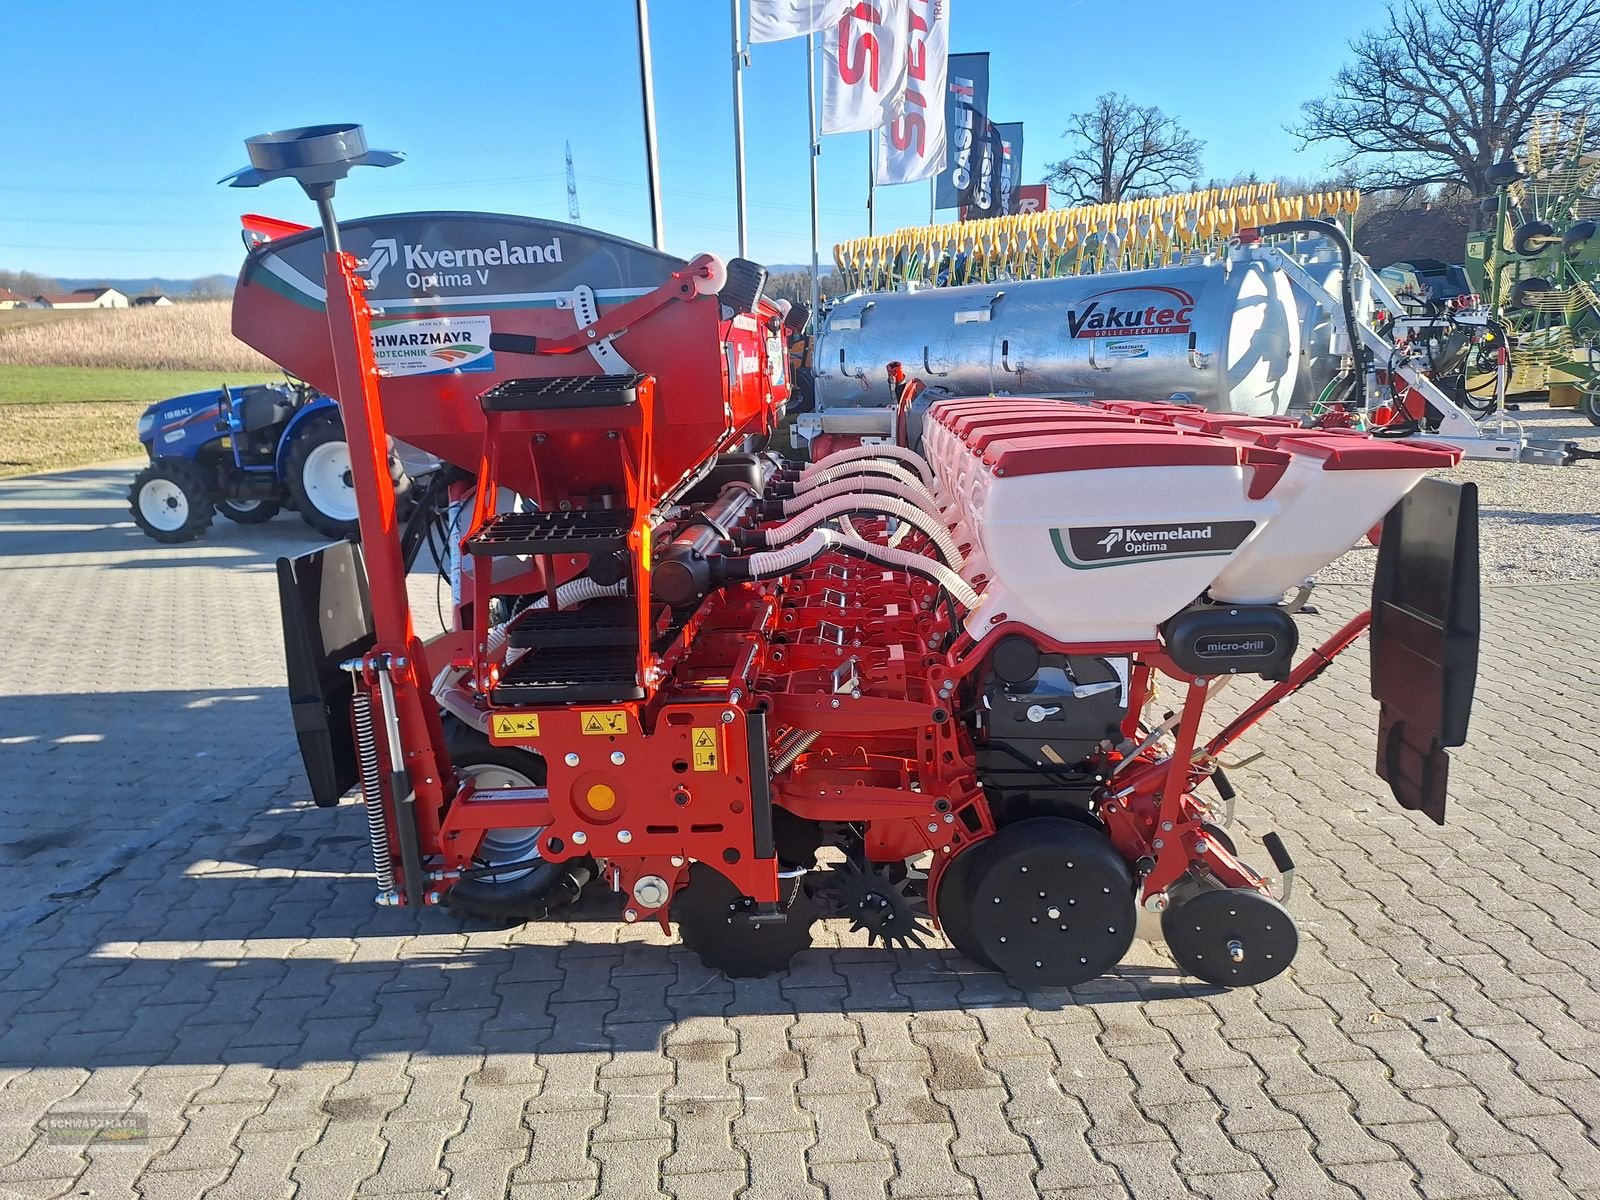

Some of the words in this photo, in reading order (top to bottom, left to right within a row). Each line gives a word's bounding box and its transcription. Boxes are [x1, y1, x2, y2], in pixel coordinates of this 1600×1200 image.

[952, 106, 974, 190] CASE
[403, 237, 563, 270] Kverneland
[405, 271, 473, 292] Optima
[476, 269, 490, 286] V
[1067, 302, 1194, 339] Vakutec
[164, 406, 193, 420] ISEKI
[1126, 526, 1212, 542] Kverneland
[1124, 542, 1168, 555] Optima
[1207, 640, 1264, 652] micro-drill
